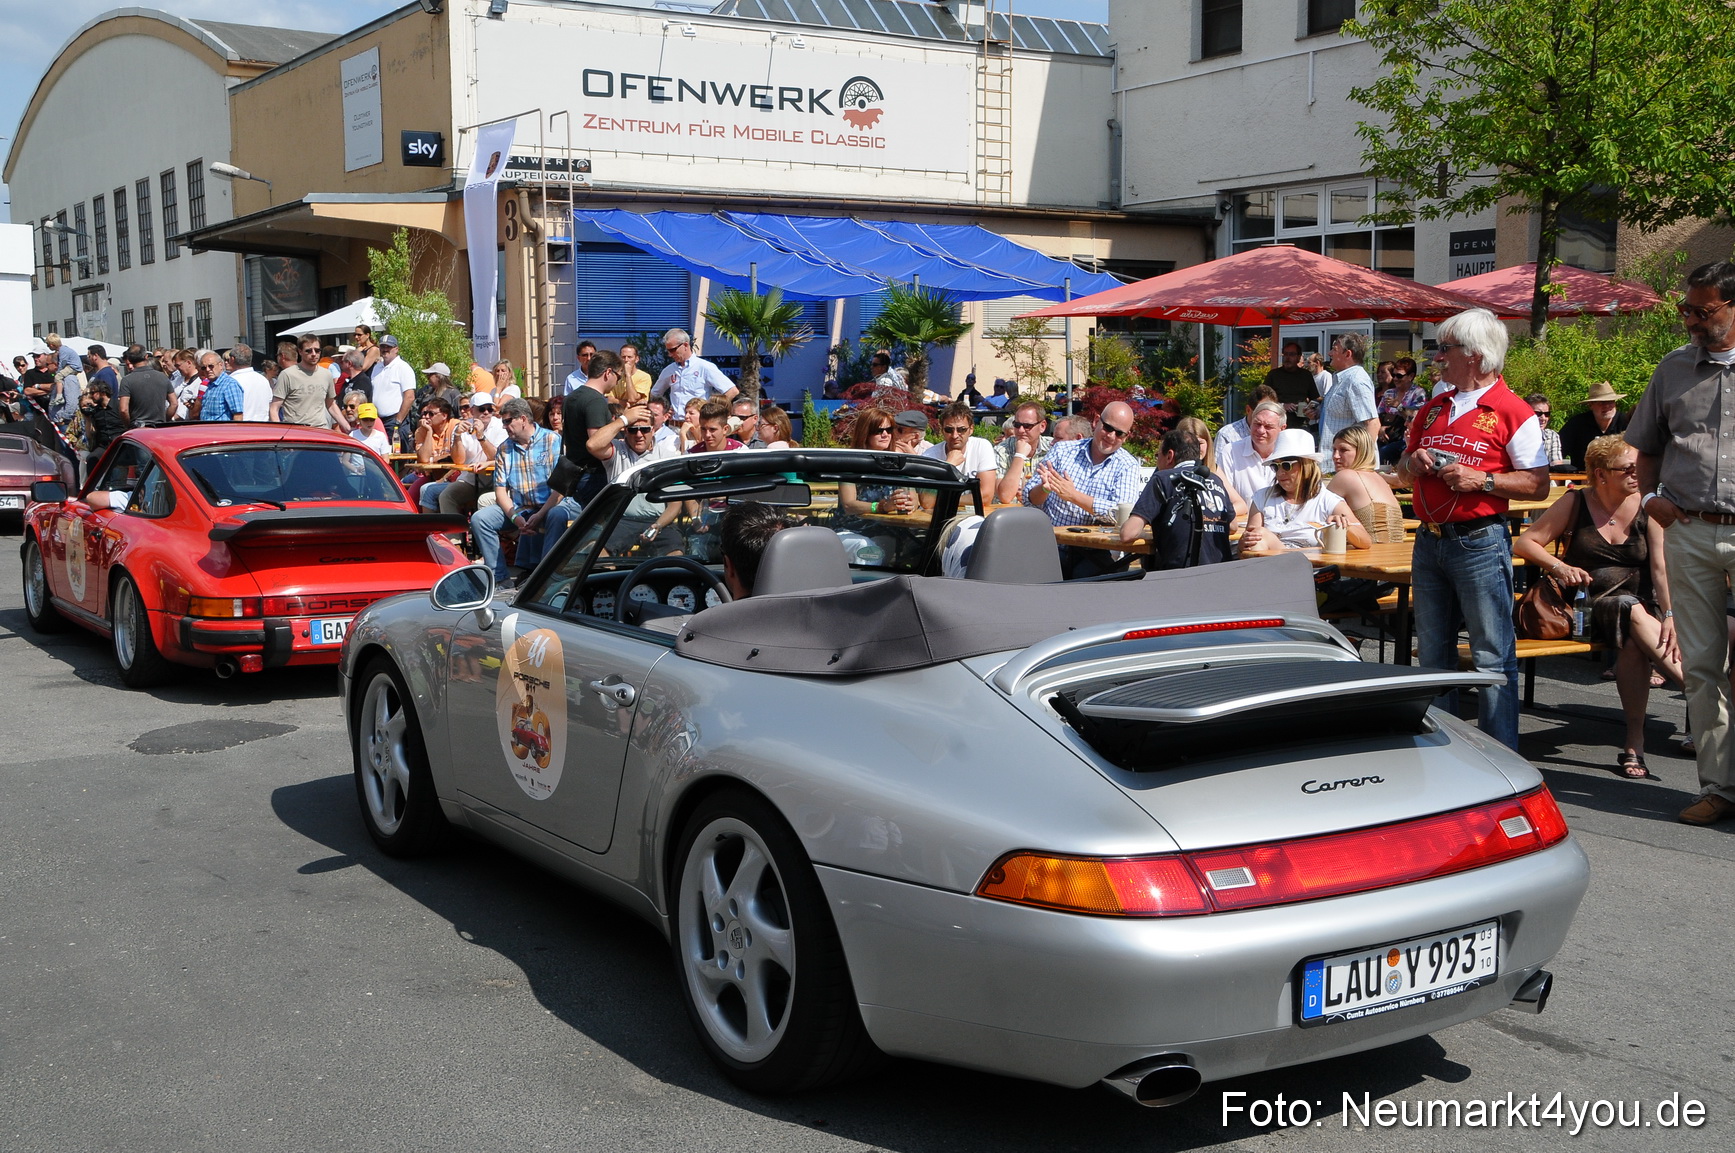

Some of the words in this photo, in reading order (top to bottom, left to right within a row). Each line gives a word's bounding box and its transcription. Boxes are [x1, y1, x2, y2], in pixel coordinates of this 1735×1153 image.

[582, 68, 835, 116] OFENWERK
[583, 113, 681, 135] ZENTRUM
[689, 120, 726, 138] FÜR
[733, 125, 804, 144] MOBILE
[811, 130, 886, 149] CLASSIC
[408, 139, 438, 158] sky
[504, 199, 518, 241] 3
[319, 555, 378, 563] Carrera
[527, 634, 550, 668] 46
[514, 672, 550, 690] PORSCHE
[526, 683, 536, 693] 911
[1301, 775, 1385, 794] Carrera
[1480, 928, 1492, 941] 03
[1325, 954, 1382, 1008] LAU
[1405, 946, 1421, 988] Y
[1429, 932, 1477, 984] 993
[1481, 956, 1492, 969] 10
[1309, 994, 1317, 1008] D
[1346, 1009, 1364, 1020] Cuntz
[1364, 1002, 1399, 1016] Autoservice
[1399, 995, 1426, 1008] Nürnberg
